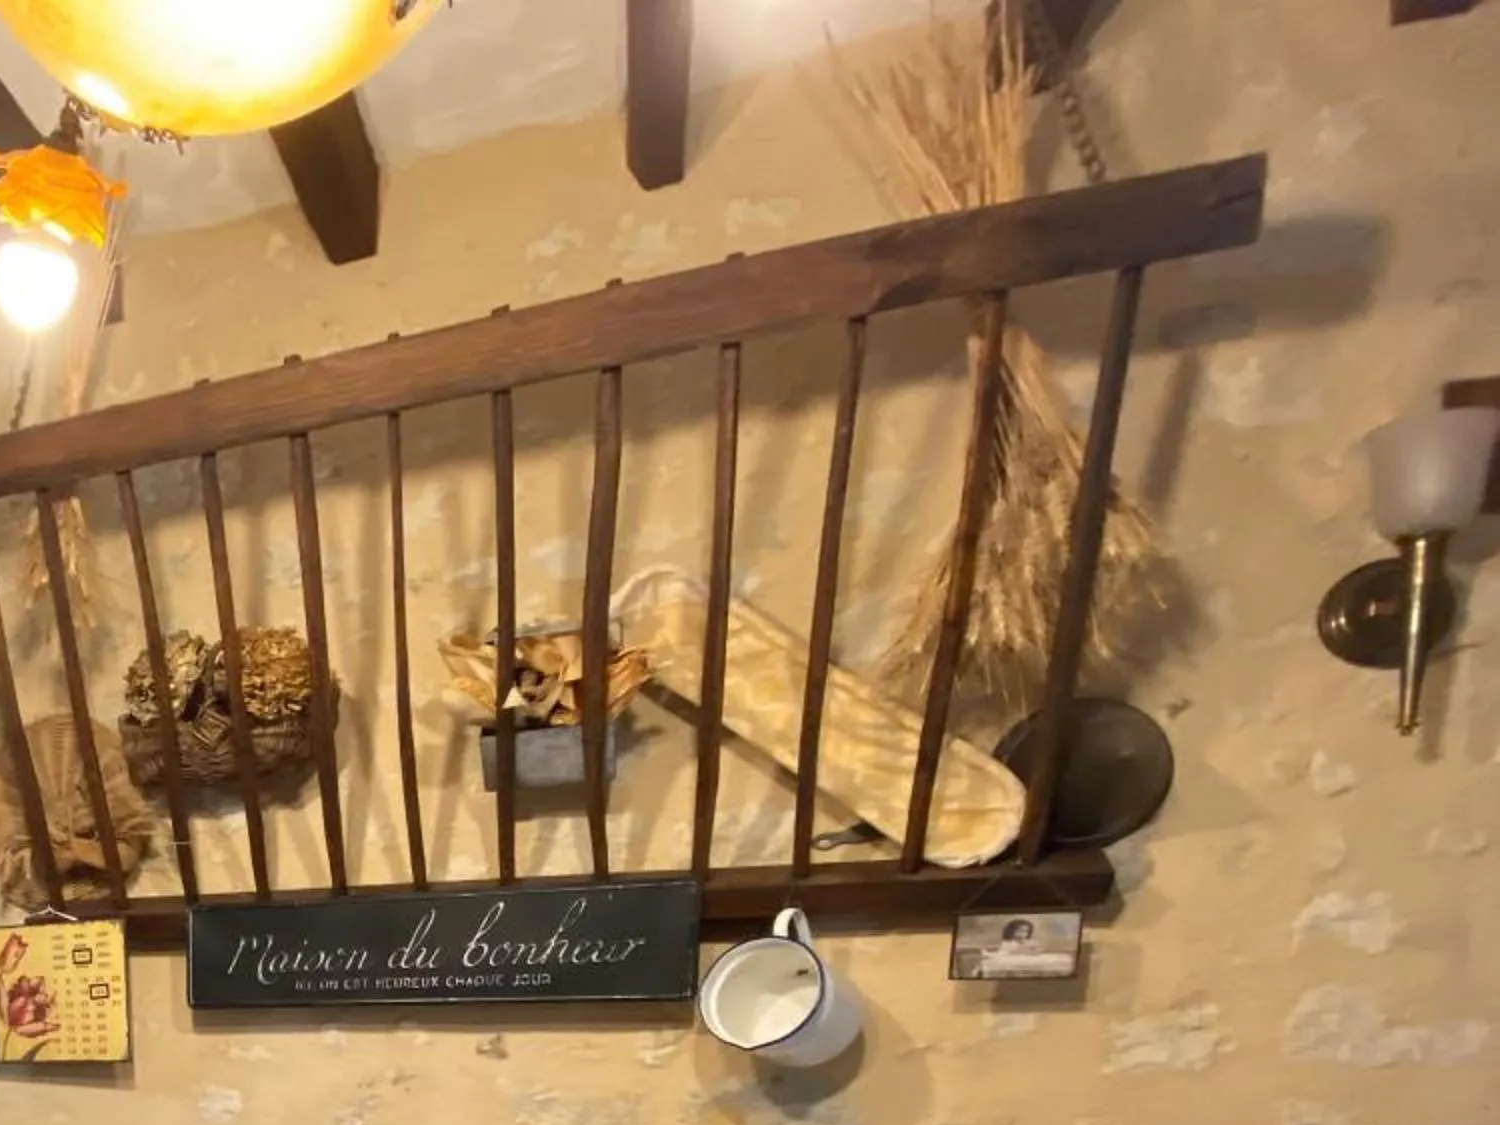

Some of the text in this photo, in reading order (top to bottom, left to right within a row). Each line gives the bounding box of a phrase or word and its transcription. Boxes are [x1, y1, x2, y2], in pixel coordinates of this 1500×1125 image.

[227, 898, 647, 985] Maison du bonheur
[375, 975, 440, 989] HEUREUX
[445, 974, 505, 988] CHAQUE
[511, 973, 552, 987] JOUR
